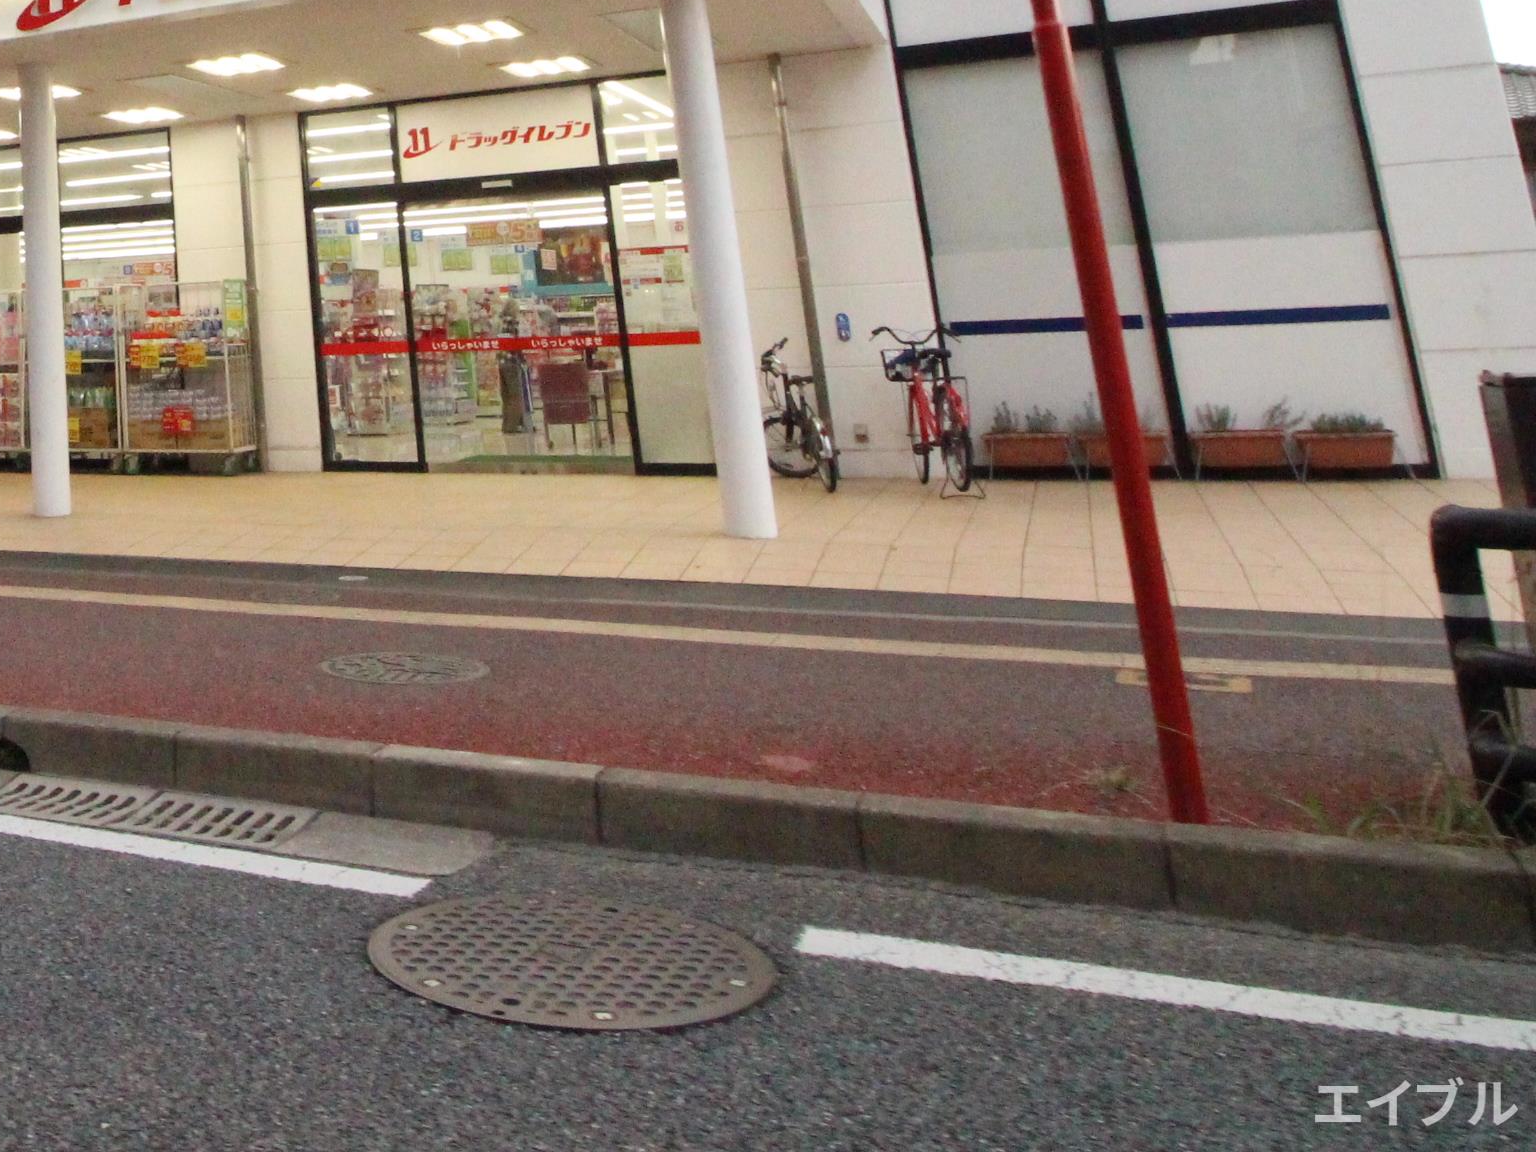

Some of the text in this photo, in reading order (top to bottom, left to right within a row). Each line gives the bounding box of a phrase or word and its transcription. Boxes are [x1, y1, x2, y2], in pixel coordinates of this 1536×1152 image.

[449, 121, 591, 151] ドラッグイレブン
[431, 340, 500, 351] いらっしゃいませ
[531, 337, 603, 349] いらっしゃいませ
